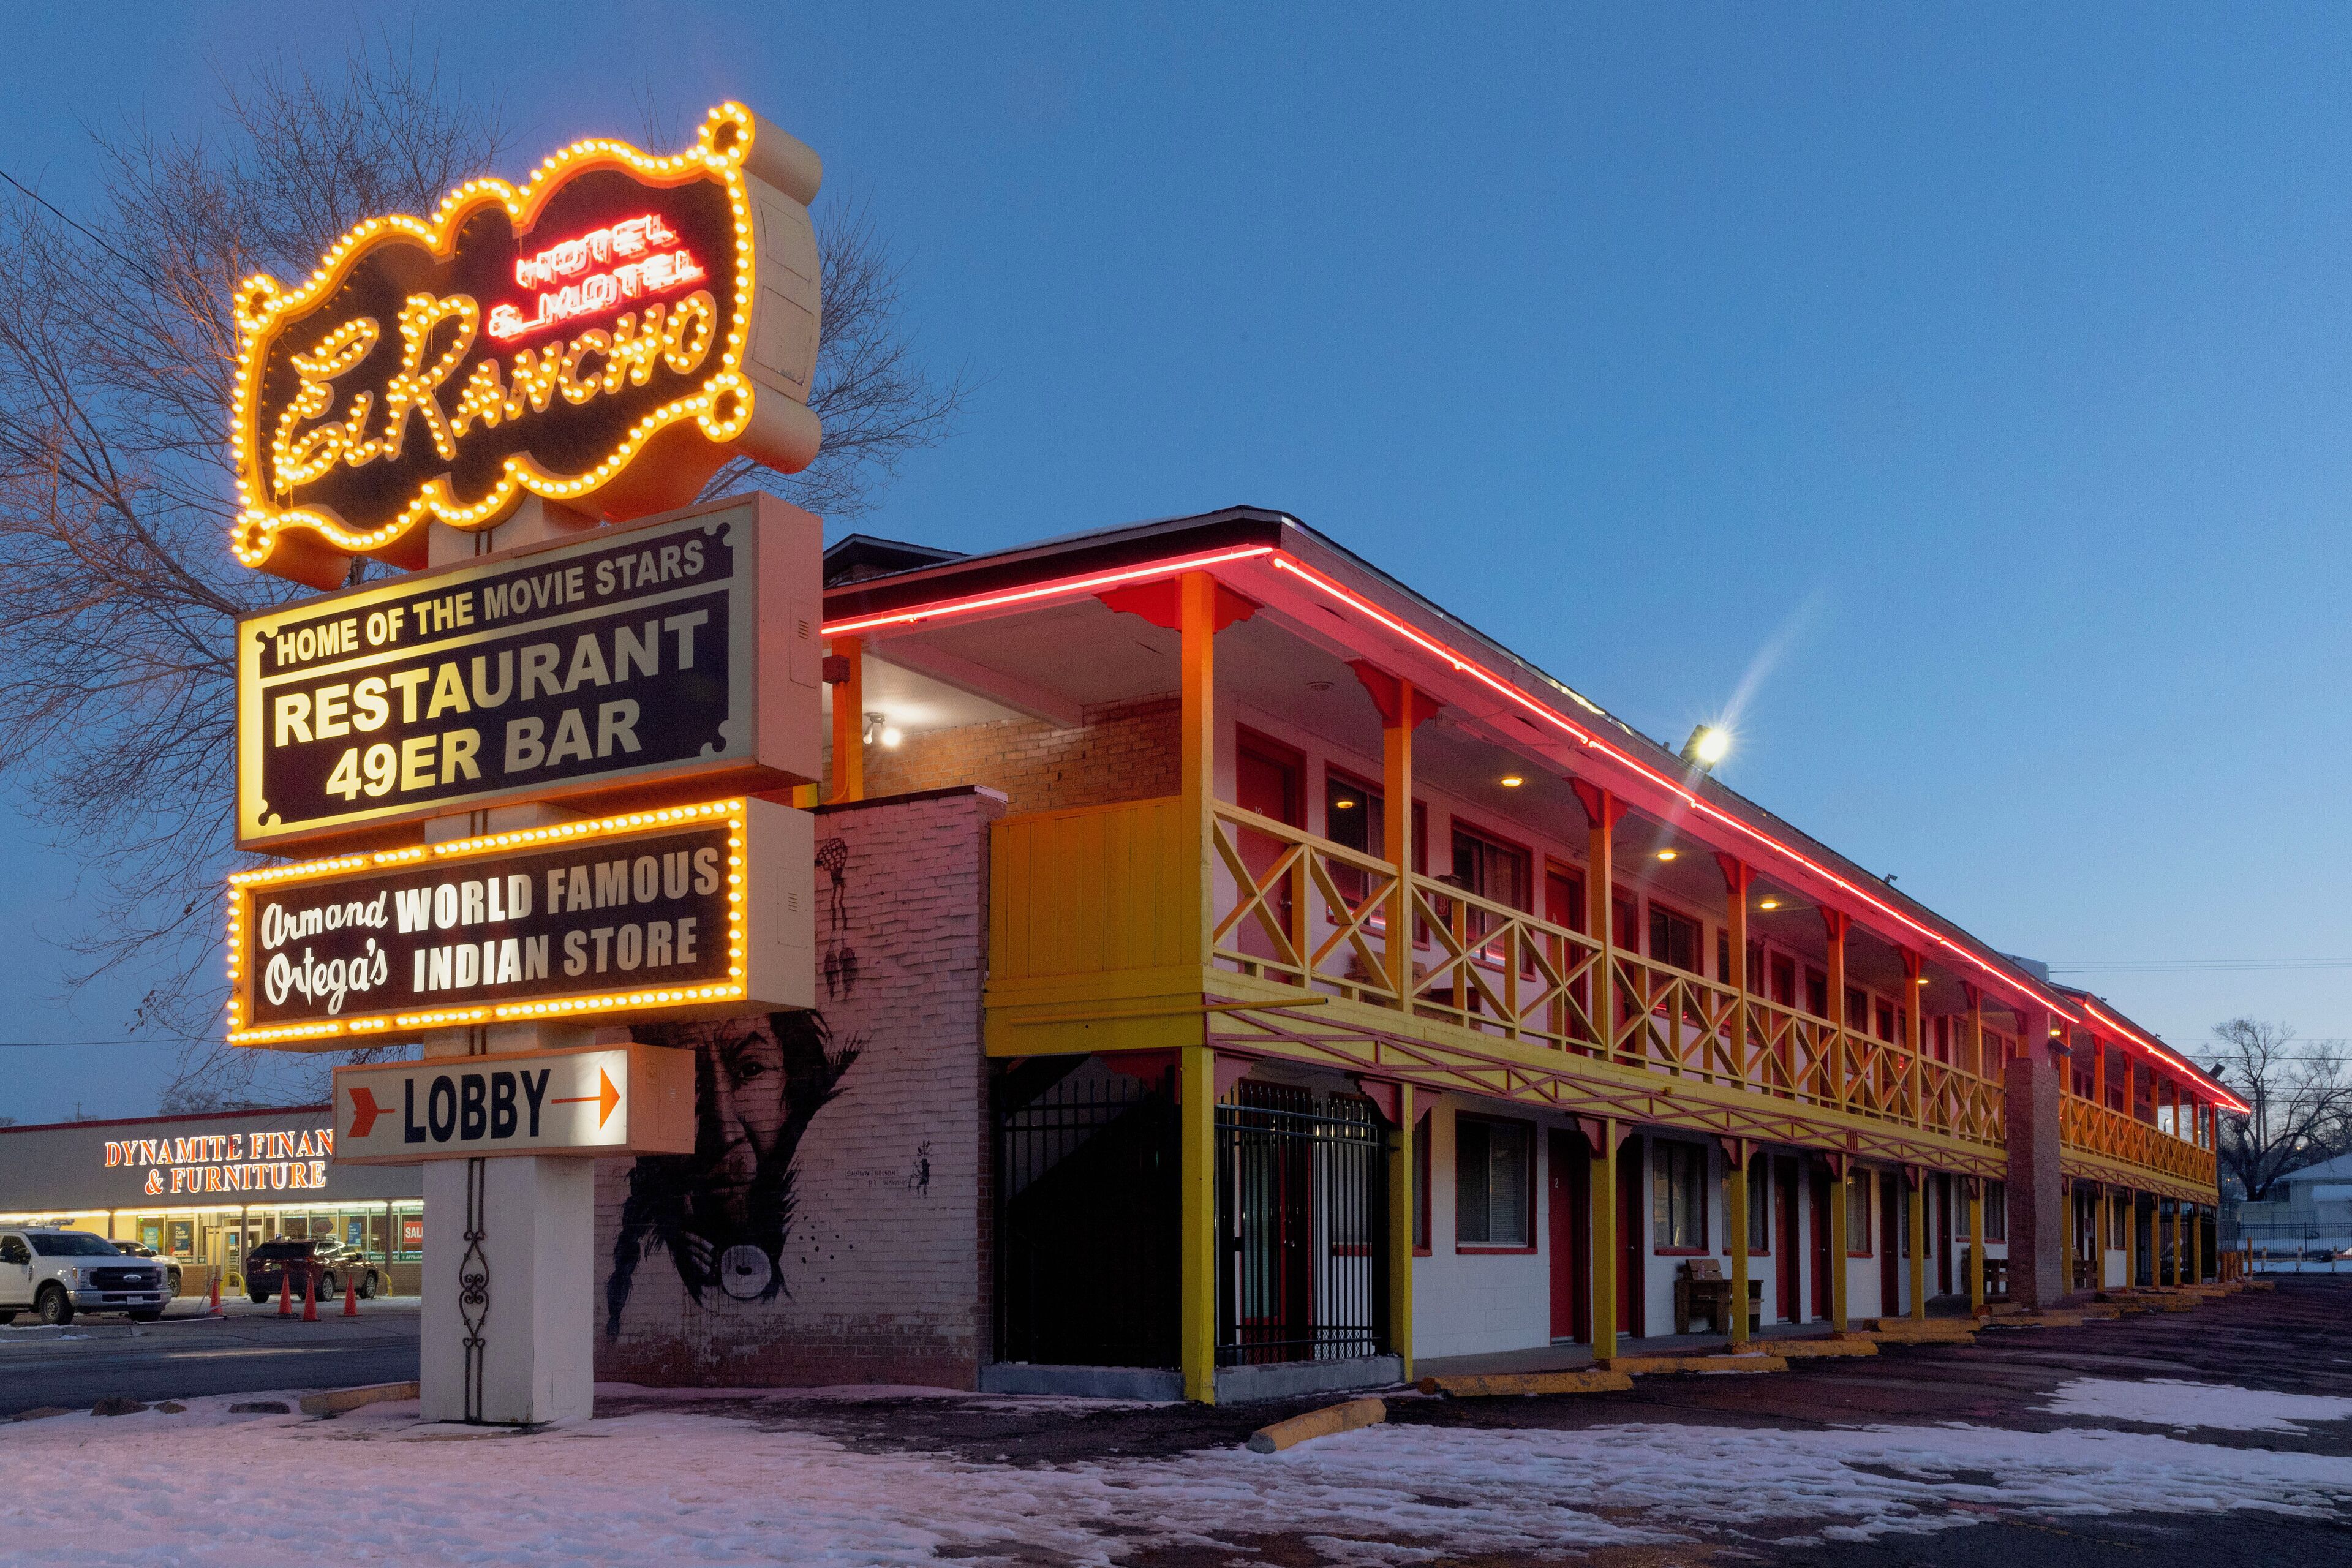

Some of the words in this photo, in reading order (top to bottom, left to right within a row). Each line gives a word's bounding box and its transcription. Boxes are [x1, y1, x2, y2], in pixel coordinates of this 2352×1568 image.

[516, 214, 677, 289] HOTEL
[489, 304, 522, 339] &
[539, 250, 703, 325] MOTEL
[277, 622, 358, 666] HOME
[366, 608, 404, 647] OF
[412, 591, 474, 636] THE
[484, 566, 586, 621] MOVIE
[595, 539, 706, 596] STARS
[274, 609, 709, 747] RESTAURANT
[325, 728, 481, 802] 49ER
[504, 698, 642, 775] BAR
[260, 891, 388, 951] Armand
[394, 873, 532, 934] WORLD
[547, 846, 720, 916] FAMOUS
[264, 937, 388, 1015] Ortega's
[413, 935, 549, 992] INDIAN
[564, 916, 698, 977] STORE
[404, 1068, 551, 1144] LOBBY
[105, 1134, 243, 1167] DYNAMITE
[249, 1128, 333, 1159] FINAN
[145, 1169, 164, 1196] &
[170, 1160, 326, 1194] FURNITURE
[1555, 1177, 1559, 1189] 2
[405, 1227, 423, 1238] SAL
